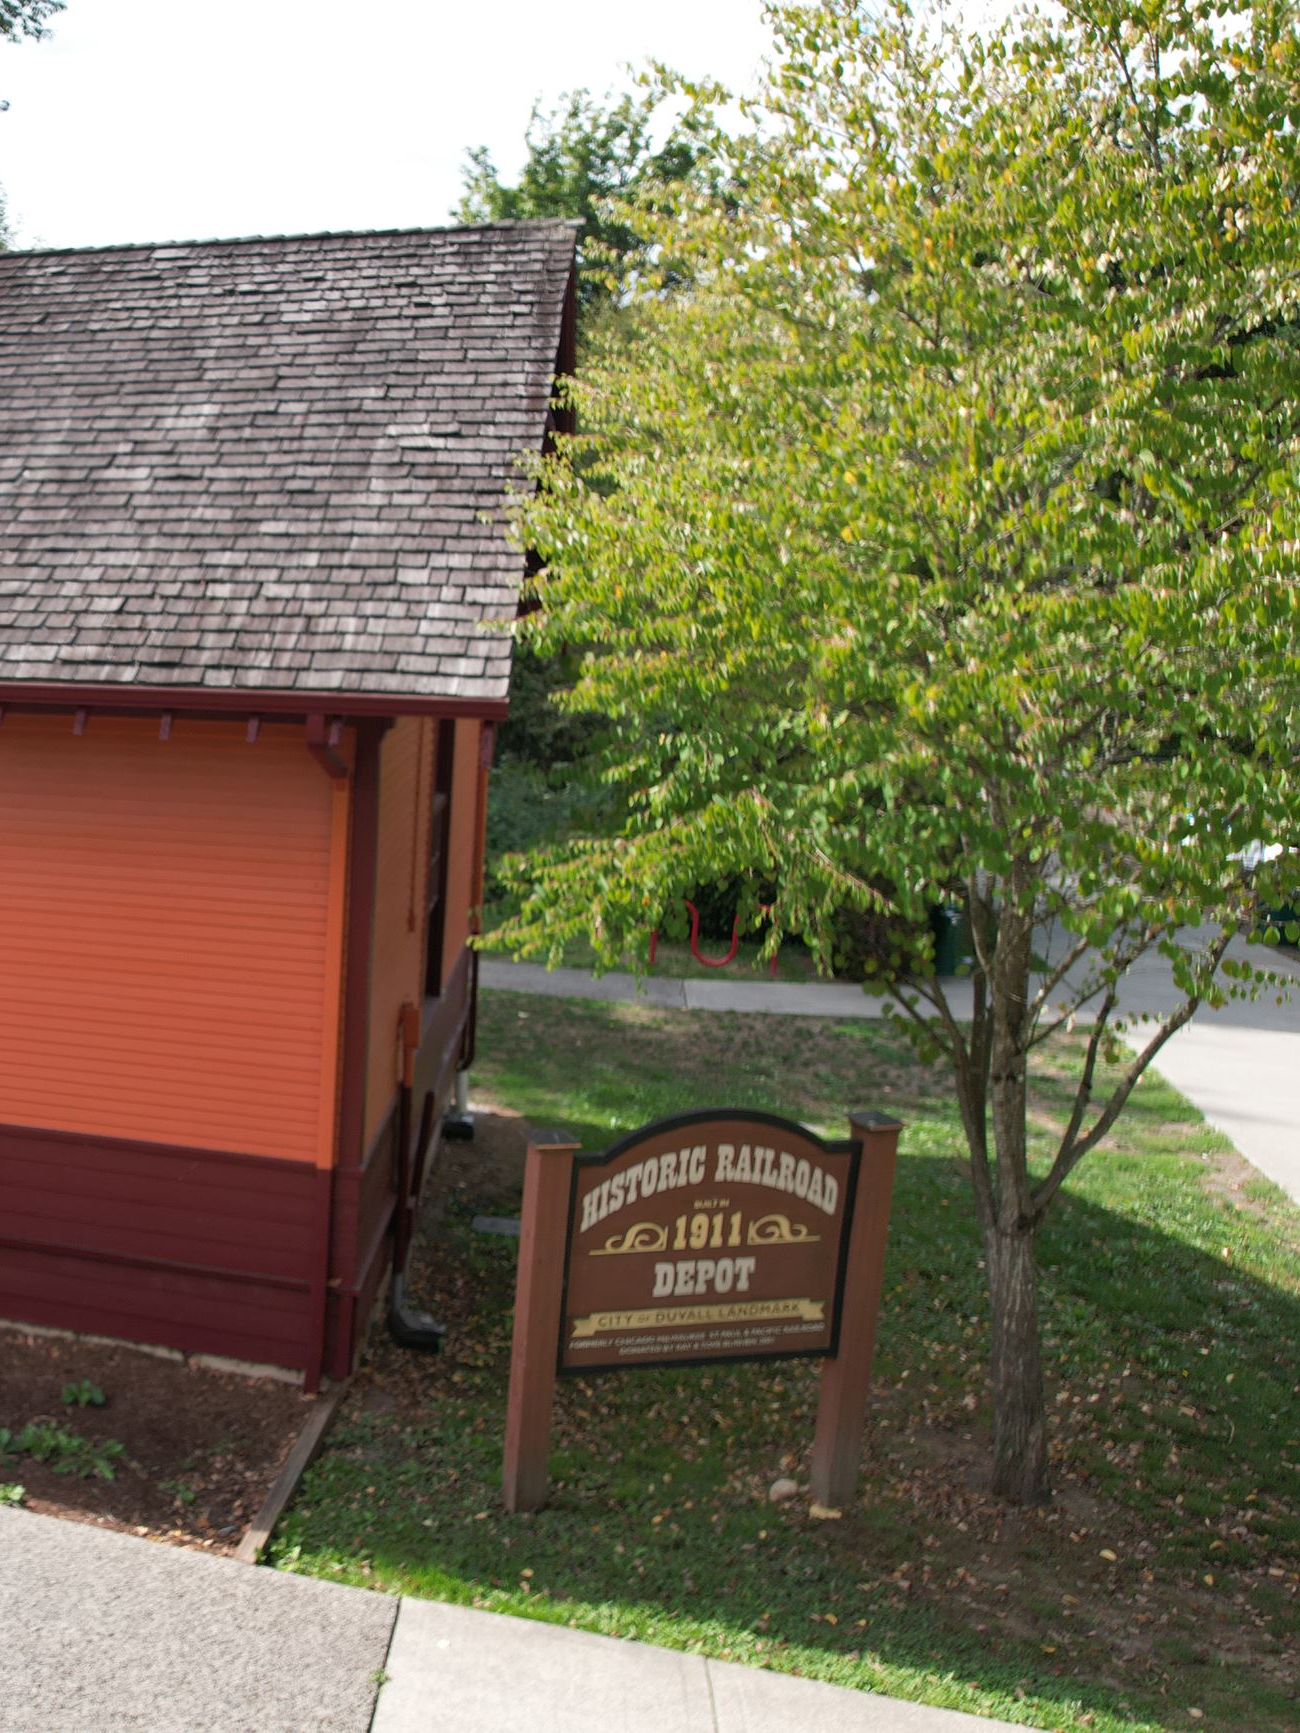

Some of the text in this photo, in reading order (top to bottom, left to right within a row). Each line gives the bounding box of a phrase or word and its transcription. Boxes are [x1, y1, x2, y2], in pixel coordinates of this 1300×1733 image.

[580, 1143, 839, 1234] HISTORIC RAILROAD
[693, 1197, 730, 1210] BUILT IN
[673, 1211, 743, 1250] 1911
[652, 1256, 756, 1298] DEPOT
[597, 1314, 633, 1328] CITY
[654, 1308, 712, 1324] DUVALL
[717, 1302, 801, 1318] LANDMARK
